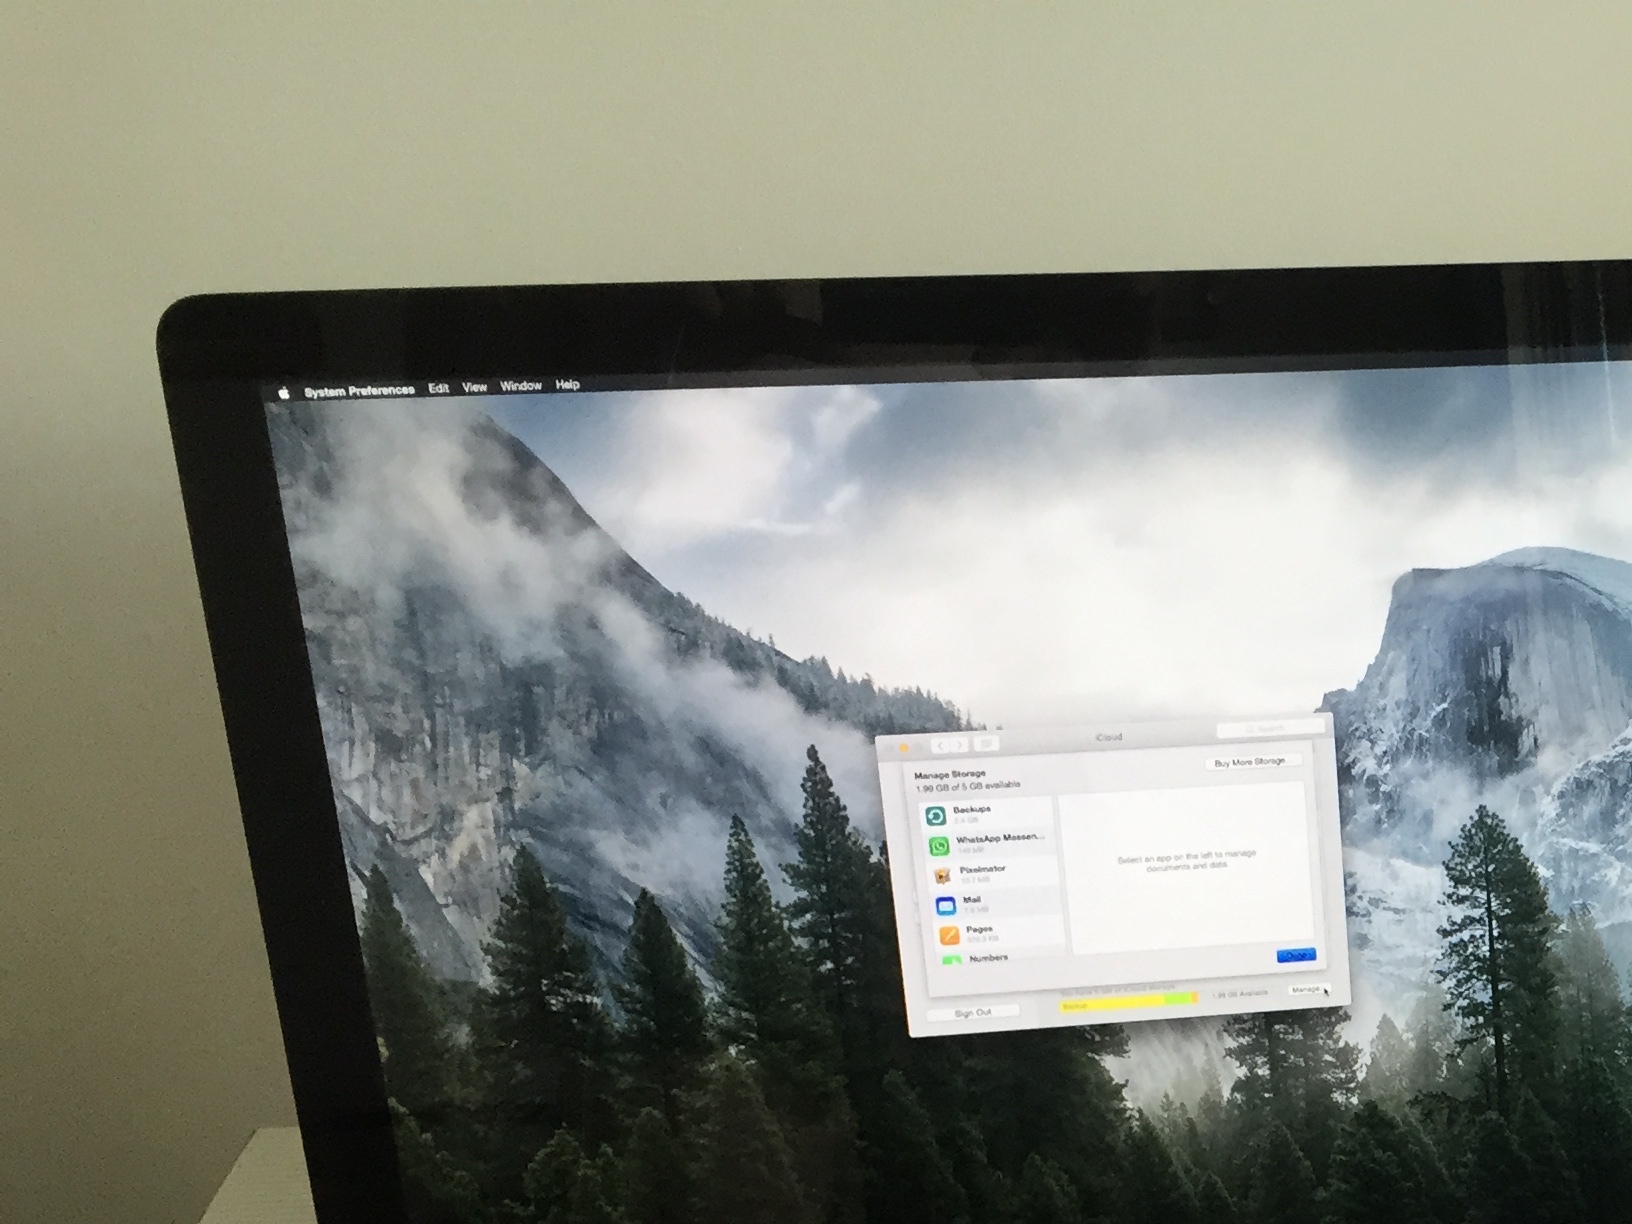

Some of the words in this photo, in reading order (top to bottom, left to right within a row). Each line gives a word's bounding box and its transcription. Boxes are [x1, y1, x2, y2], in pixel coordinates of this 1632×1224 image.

[428, 382, 450, 394] Edit
[462, 381, 488, 393] View
[499, 380, 542, 392] Window
[555, 379, 580, 391] Help
[304, 386, 346, 399] System
[348, 384, 415, 397] Preferences
[1215, 759, 1230, 769] Buy
[1232, 758, 1253, 767] More
[914, 772, 950, 781] Manage
[952, 770, 986, 780] Storage
[985, 780, 1021, 790] available
[956, 835, 1001, 845] WhatsApp
[966, 926, 993, 935] Pages
[969, 953, 1009, 963] Numbers
[955, 1010, 975, 1019] Sign
[976, 1008, 992, 1017] Out
